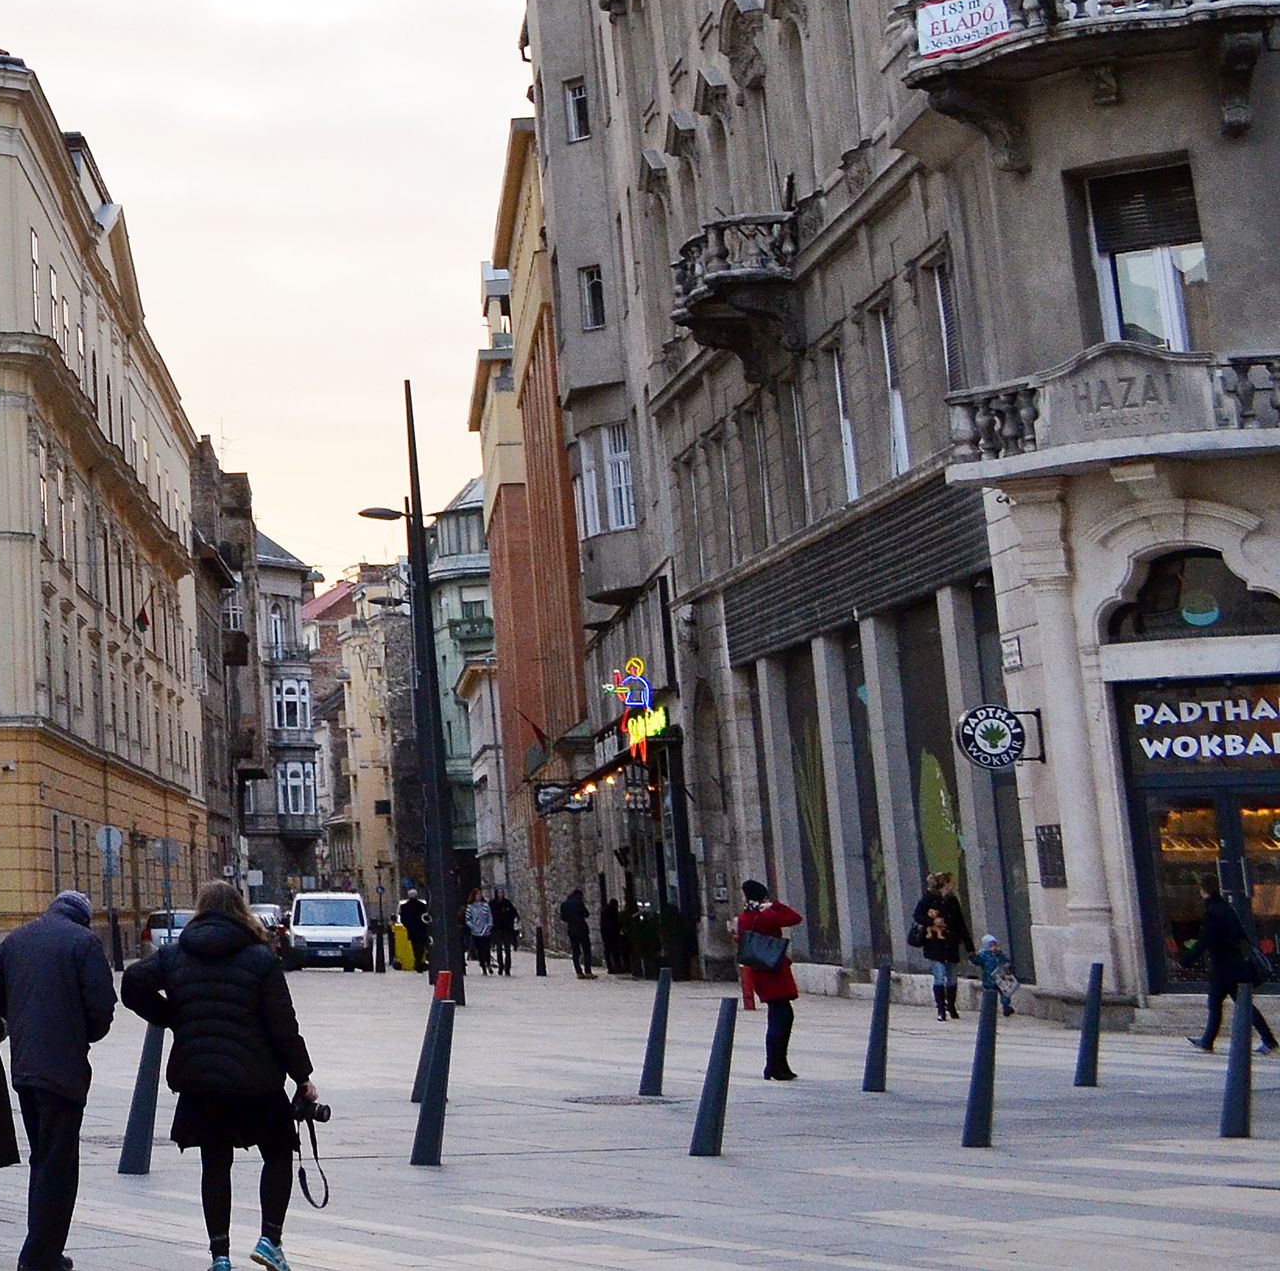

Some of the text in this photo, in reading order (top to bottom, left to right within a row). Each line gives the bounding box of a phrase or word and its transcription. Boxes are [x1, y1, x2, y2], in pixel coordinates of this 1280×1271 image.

[930, 2, 995, 37] ELADÓ
[941, 0, 964, 16] 183
[963, 707, 1022, 736] PADTHAI
[967, 740, 1023, 766] WOKBAR
